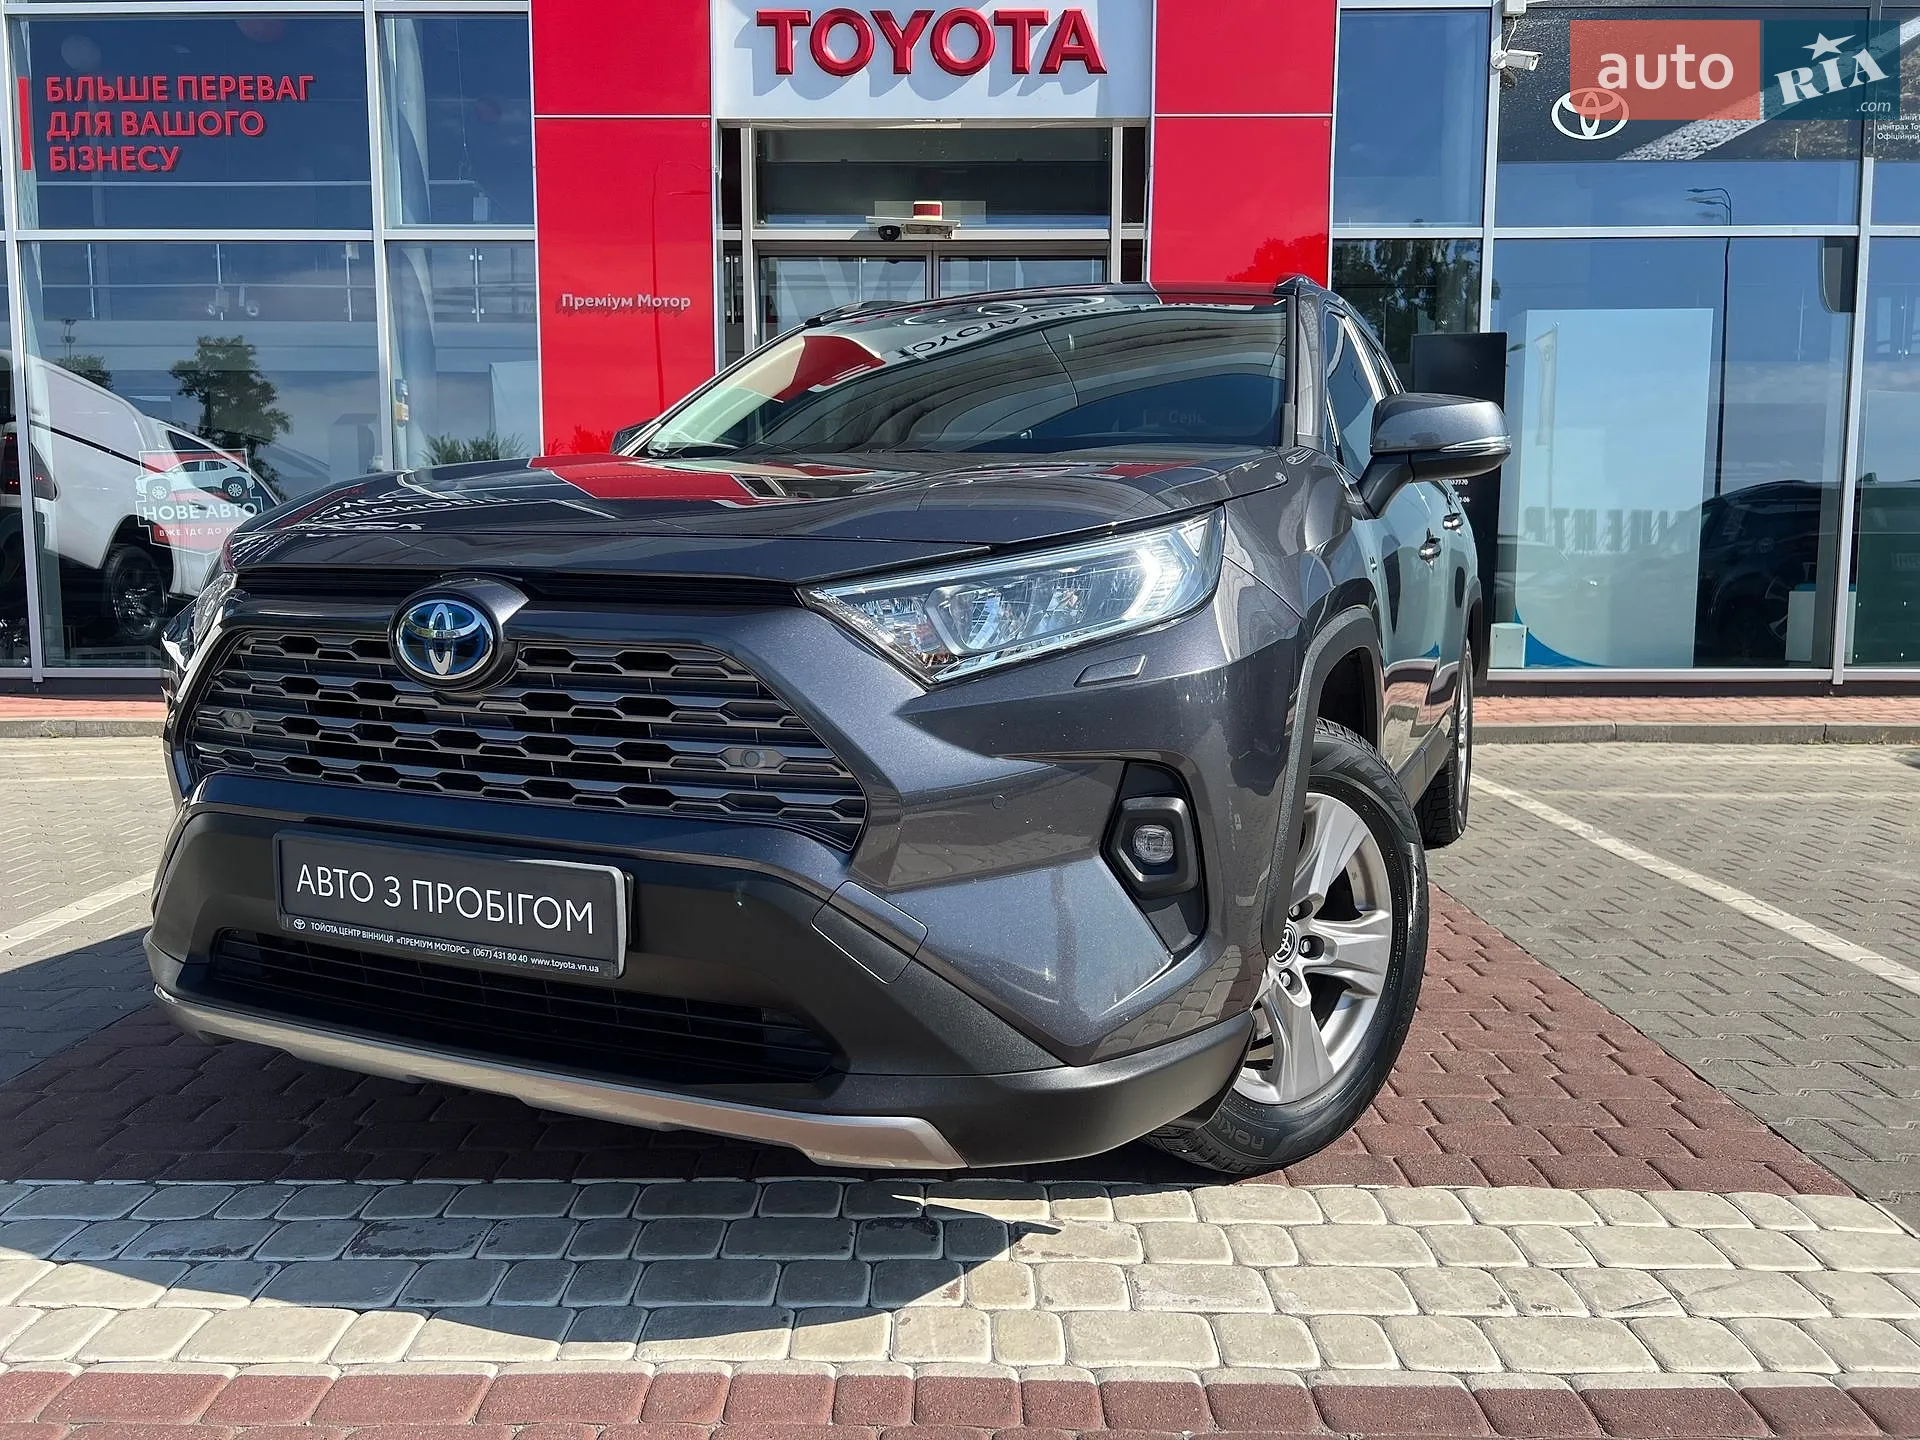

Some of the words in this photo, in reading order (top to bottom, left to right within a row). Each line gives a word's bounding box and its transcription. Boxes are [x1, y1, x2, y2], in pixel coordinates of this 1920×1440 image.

[756, 8, 1108, 77] TOYOTA
[46, 75, 168, 102] БІЛЬШЕ
[177, 75, 314, 101] ПЕРЕВАГ
[47, 111, 112, 141] ДЛЯ
[121, 111, 265, 137] ВАШОГО
[50, 146, 179, 171] БІЗНЕСУ
[561, 293, 633, 310] Преміум
[637, 293, 692, 311] Мотор
[142, 504, 201, 521] НОВЕ
[205, 502, 258, 518] АВТО
[296, 864, 374, 903] АВТО
[383, 876, 401, 908] З
[412, 879, 593, 935] ПРОБІГОМ
[310, 921, 339, 934] ТОЙОТА
[339, 926, 361, 938] ЦЕНТР
[362, 930, 394, 943] ВІННИЦЯ
[396, 936, 433, 949] «ПРЕМІУМ
[434, 942, 470, 954] МОТОРС»
[472, 946, 492, 959] (067)
[493, 949, 506, 960] 431
[507, 951, 517, 962] 80
[518, 954, 528, 963] 40
[530, 957, 600, 973] www.toyota.vn.ua
